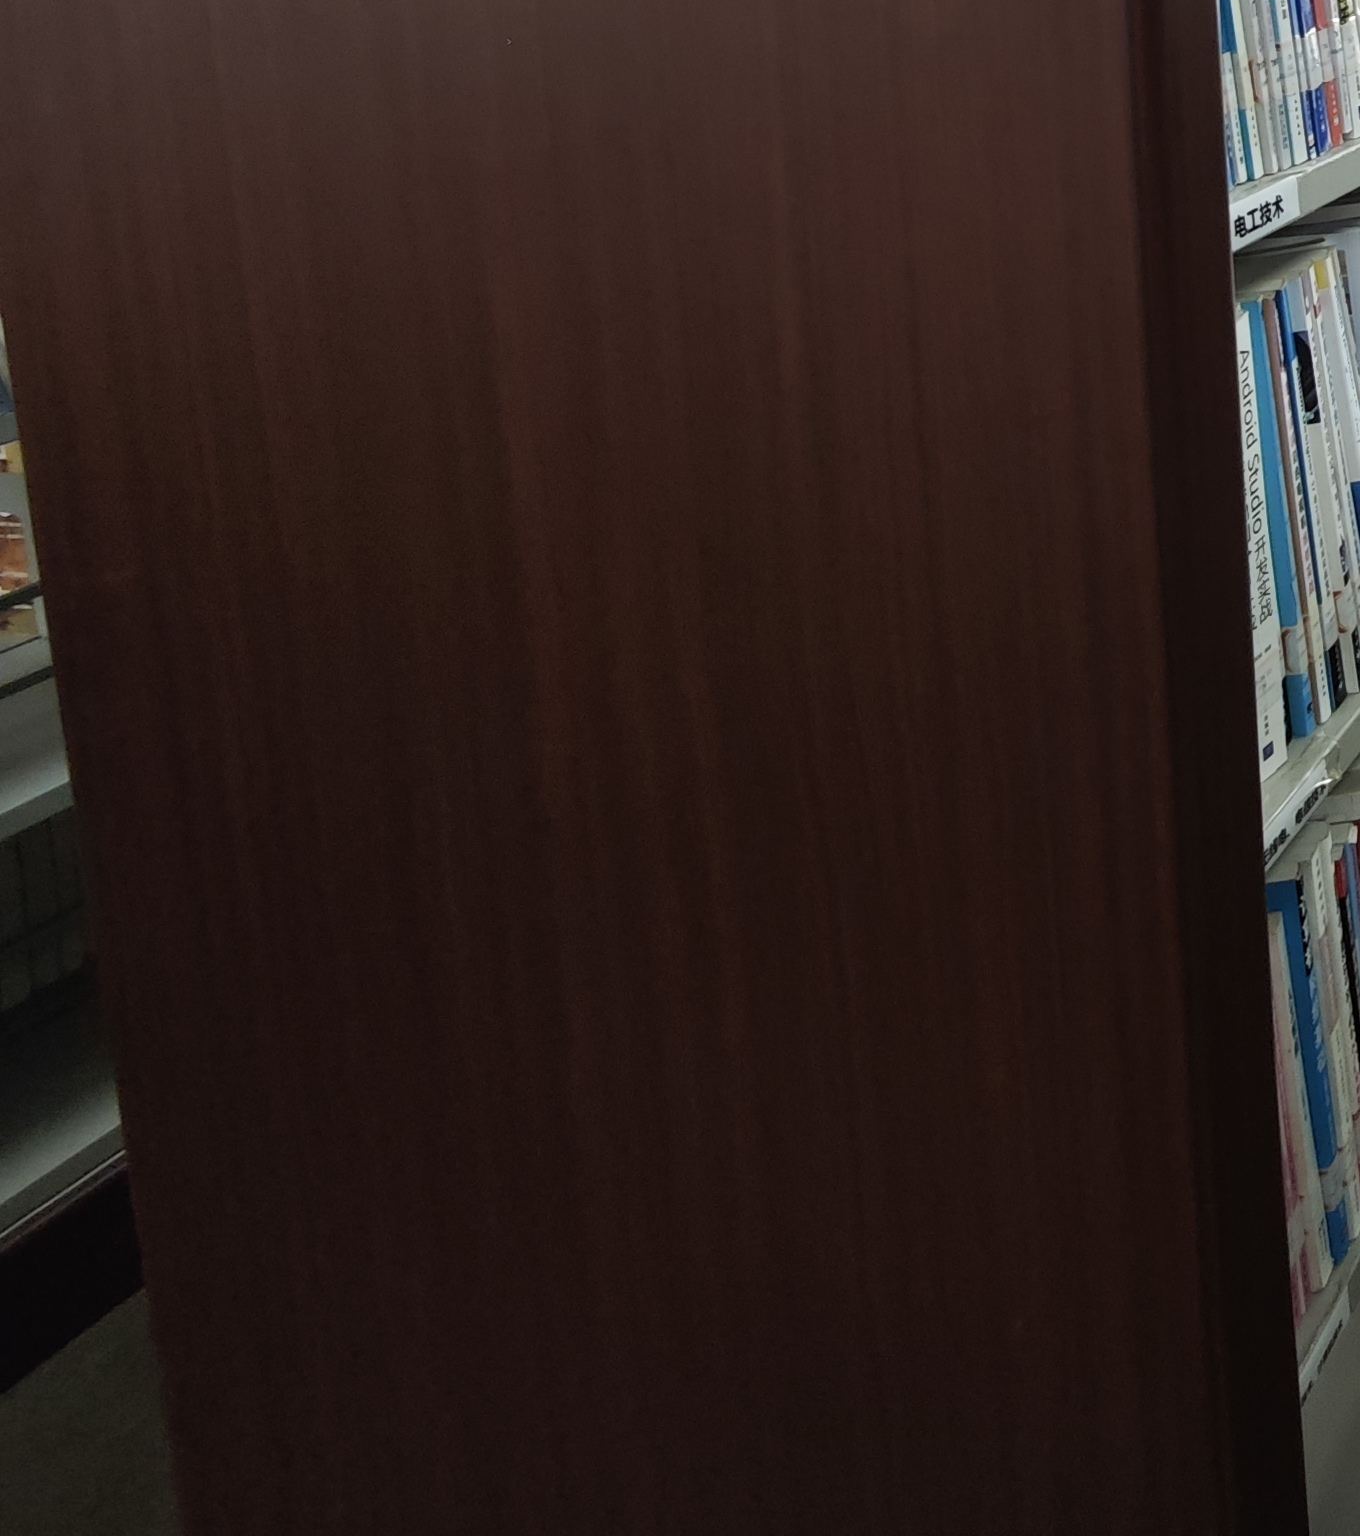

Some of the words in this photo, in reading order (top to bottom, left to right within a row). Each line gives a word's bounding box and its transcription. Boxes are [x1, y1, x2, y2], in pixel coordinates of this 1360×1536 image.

[1234, 194, 1284, 238] 电工技术
[1239, 350, 1258, 449] Android
[1248, 453, 1263, 534] Studio
